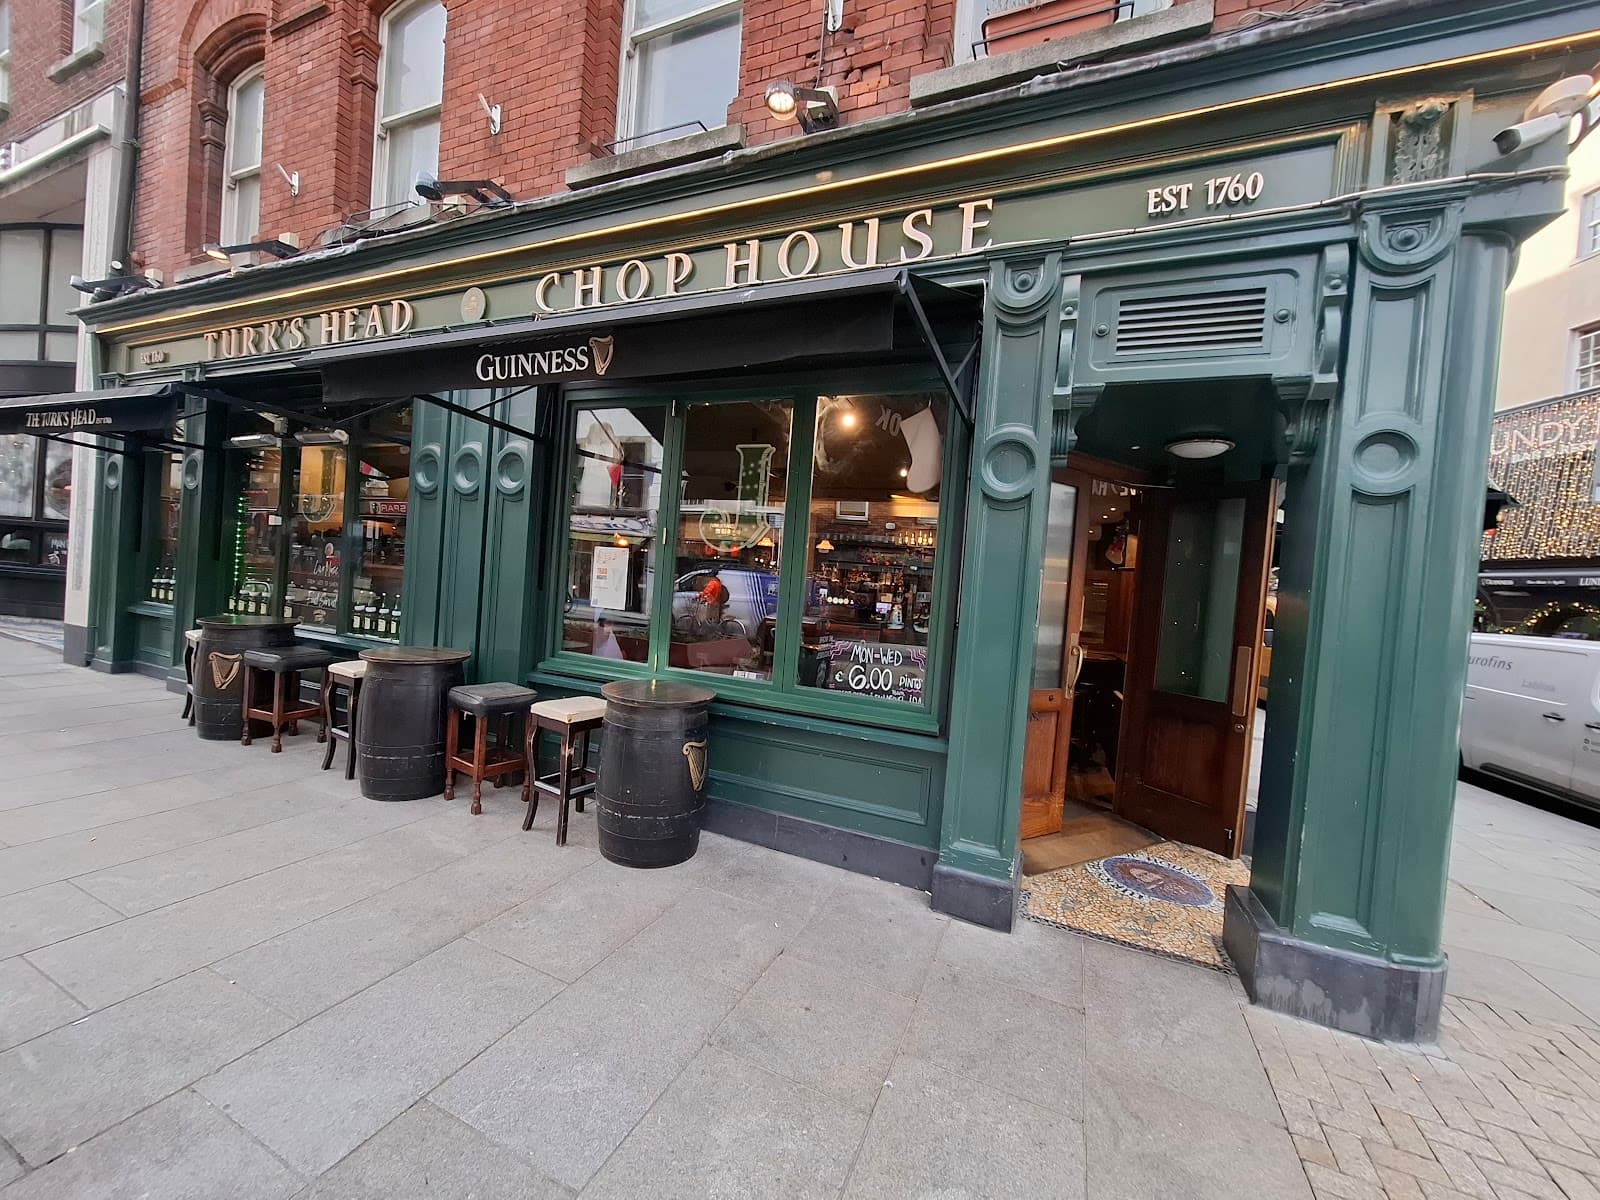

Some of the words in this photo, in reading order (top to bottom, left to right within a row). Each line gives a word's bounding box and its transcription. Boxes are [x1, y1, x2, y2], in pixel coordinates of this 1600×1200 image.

[1147, 183, 1193, 213] EST
[1204, 171, 1264, 205] 1760
[535, 252, 693, 312] CHOP
[724, 199, 993, 288] HOUSE
[203, 317, 307, 360] TURK'S
[320, 300, 414, 345] HEAD
[476, 346, 590, 381] GUINNESS
[25, 412, 41, 427] THE
[41, 411, 69, 427] TURK'S
[70, 408, 96, 429] HEAD
[1490, 414, 1586, 456] UNDY
[850, 644, 903, 667] MON-WED
[1467, 655, 1513, 671] urofins
[848, 664, 893, 691] 6.00
